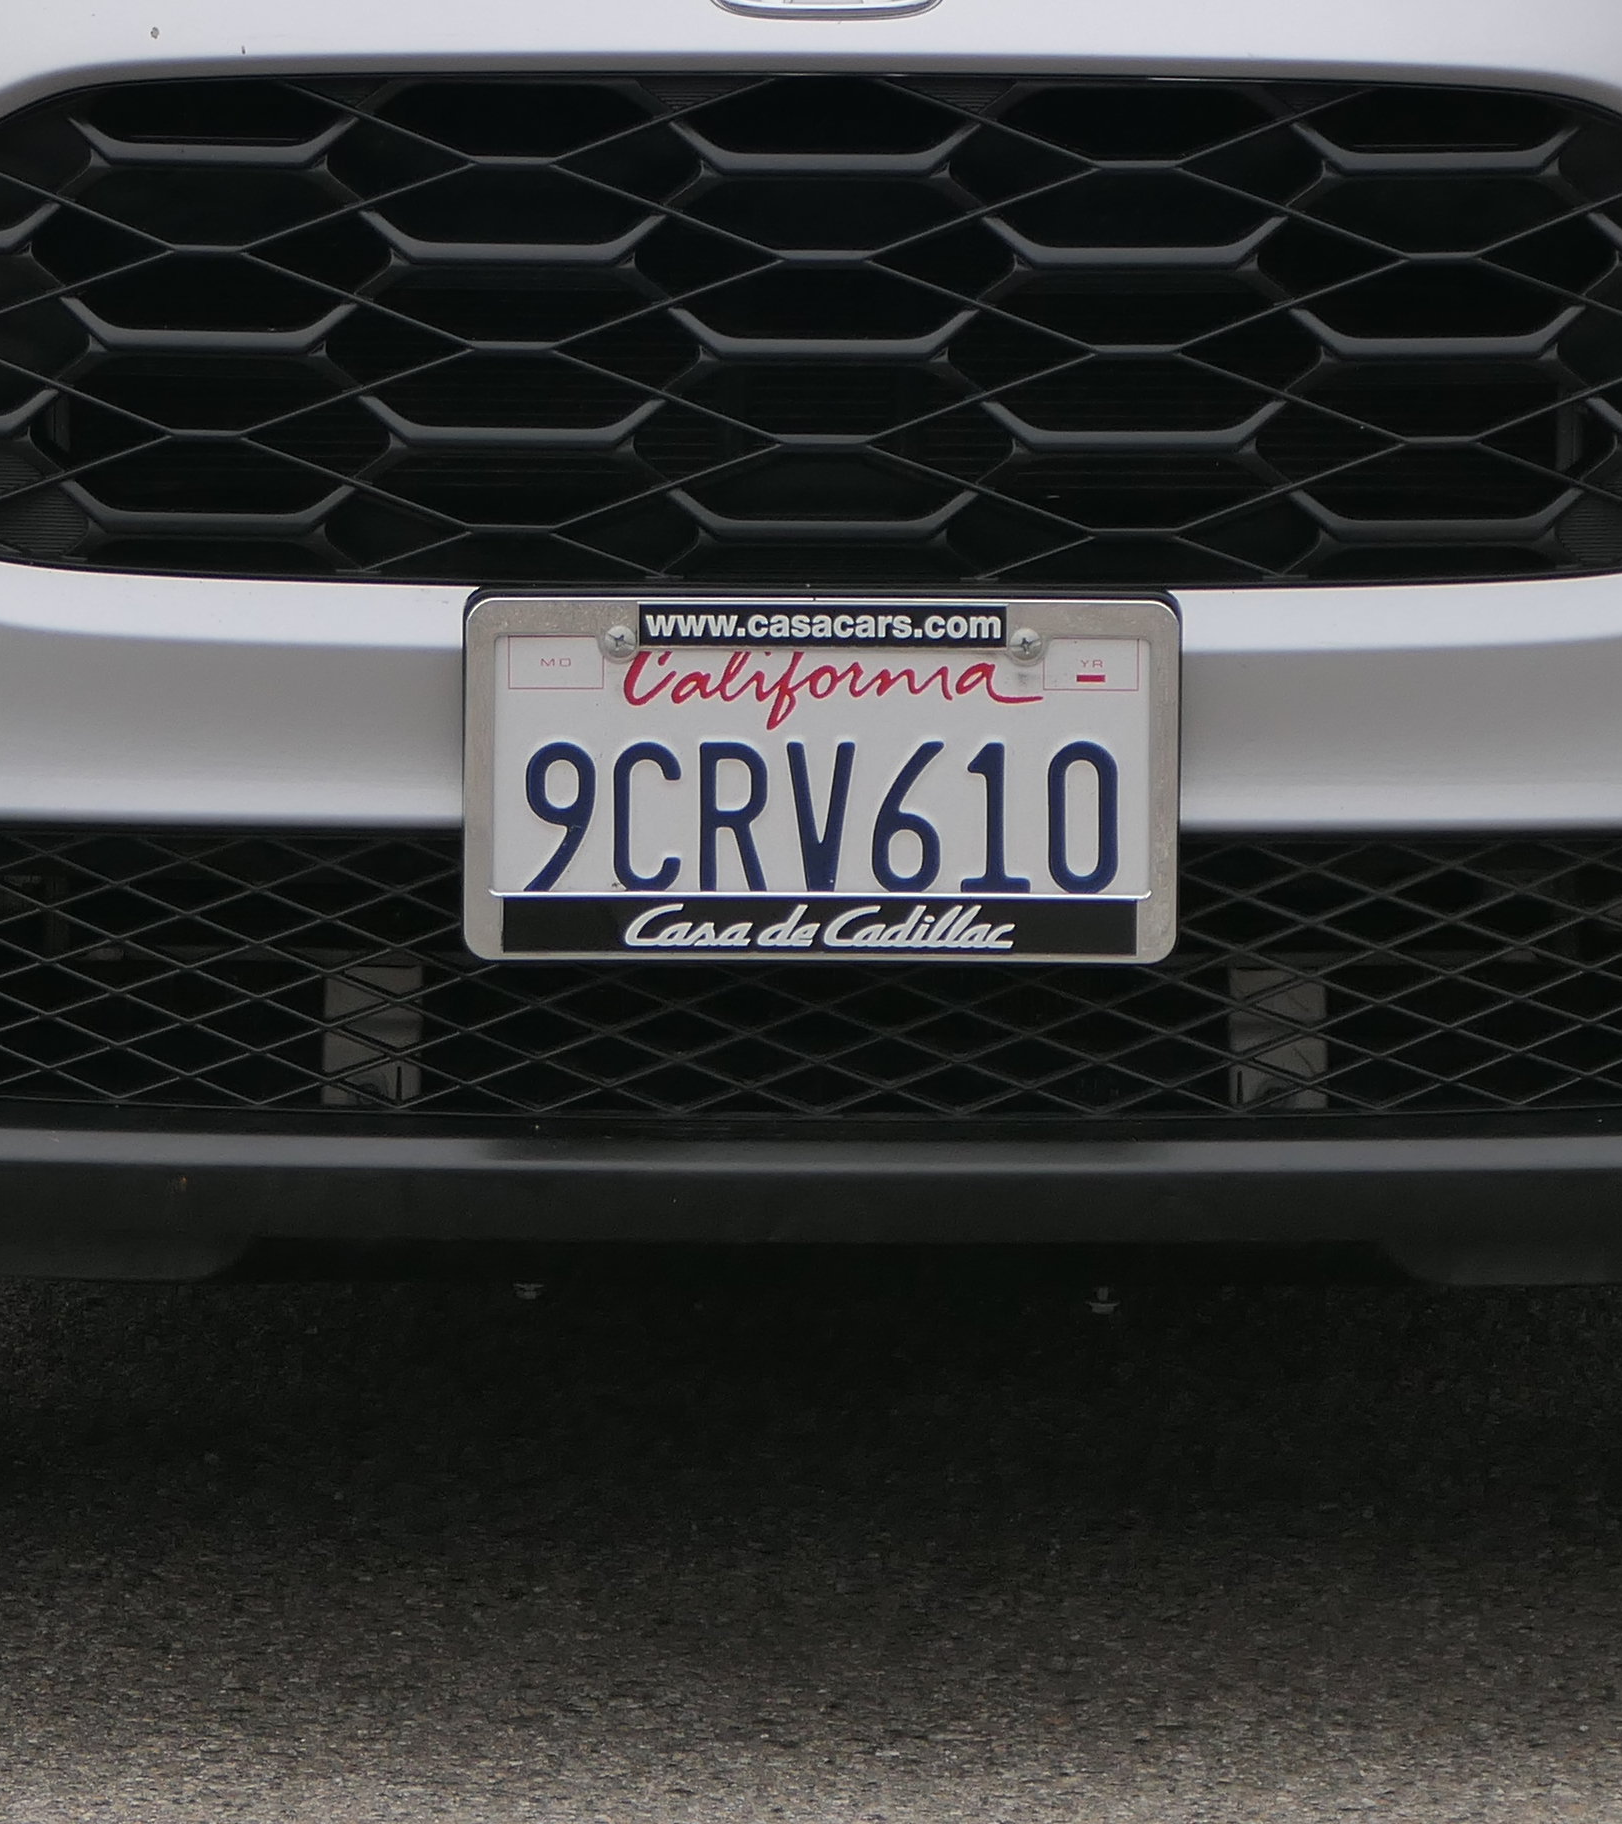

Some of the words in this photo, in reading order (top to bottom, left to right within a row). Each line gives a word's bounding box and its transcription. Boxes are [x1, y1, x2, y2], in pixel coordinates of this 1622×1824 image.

[644, 609, 1002, 641] www.casacars.com
[1080, 659, 1104, 668] YR
[622, 651, 1044, 730] California
[524, 739, 1119, 893] 9CRV610
[624, 903, 751, 949] Casa
[755, 903, 819, 949] de
[820, 903, 1016, 950] Cadillac
